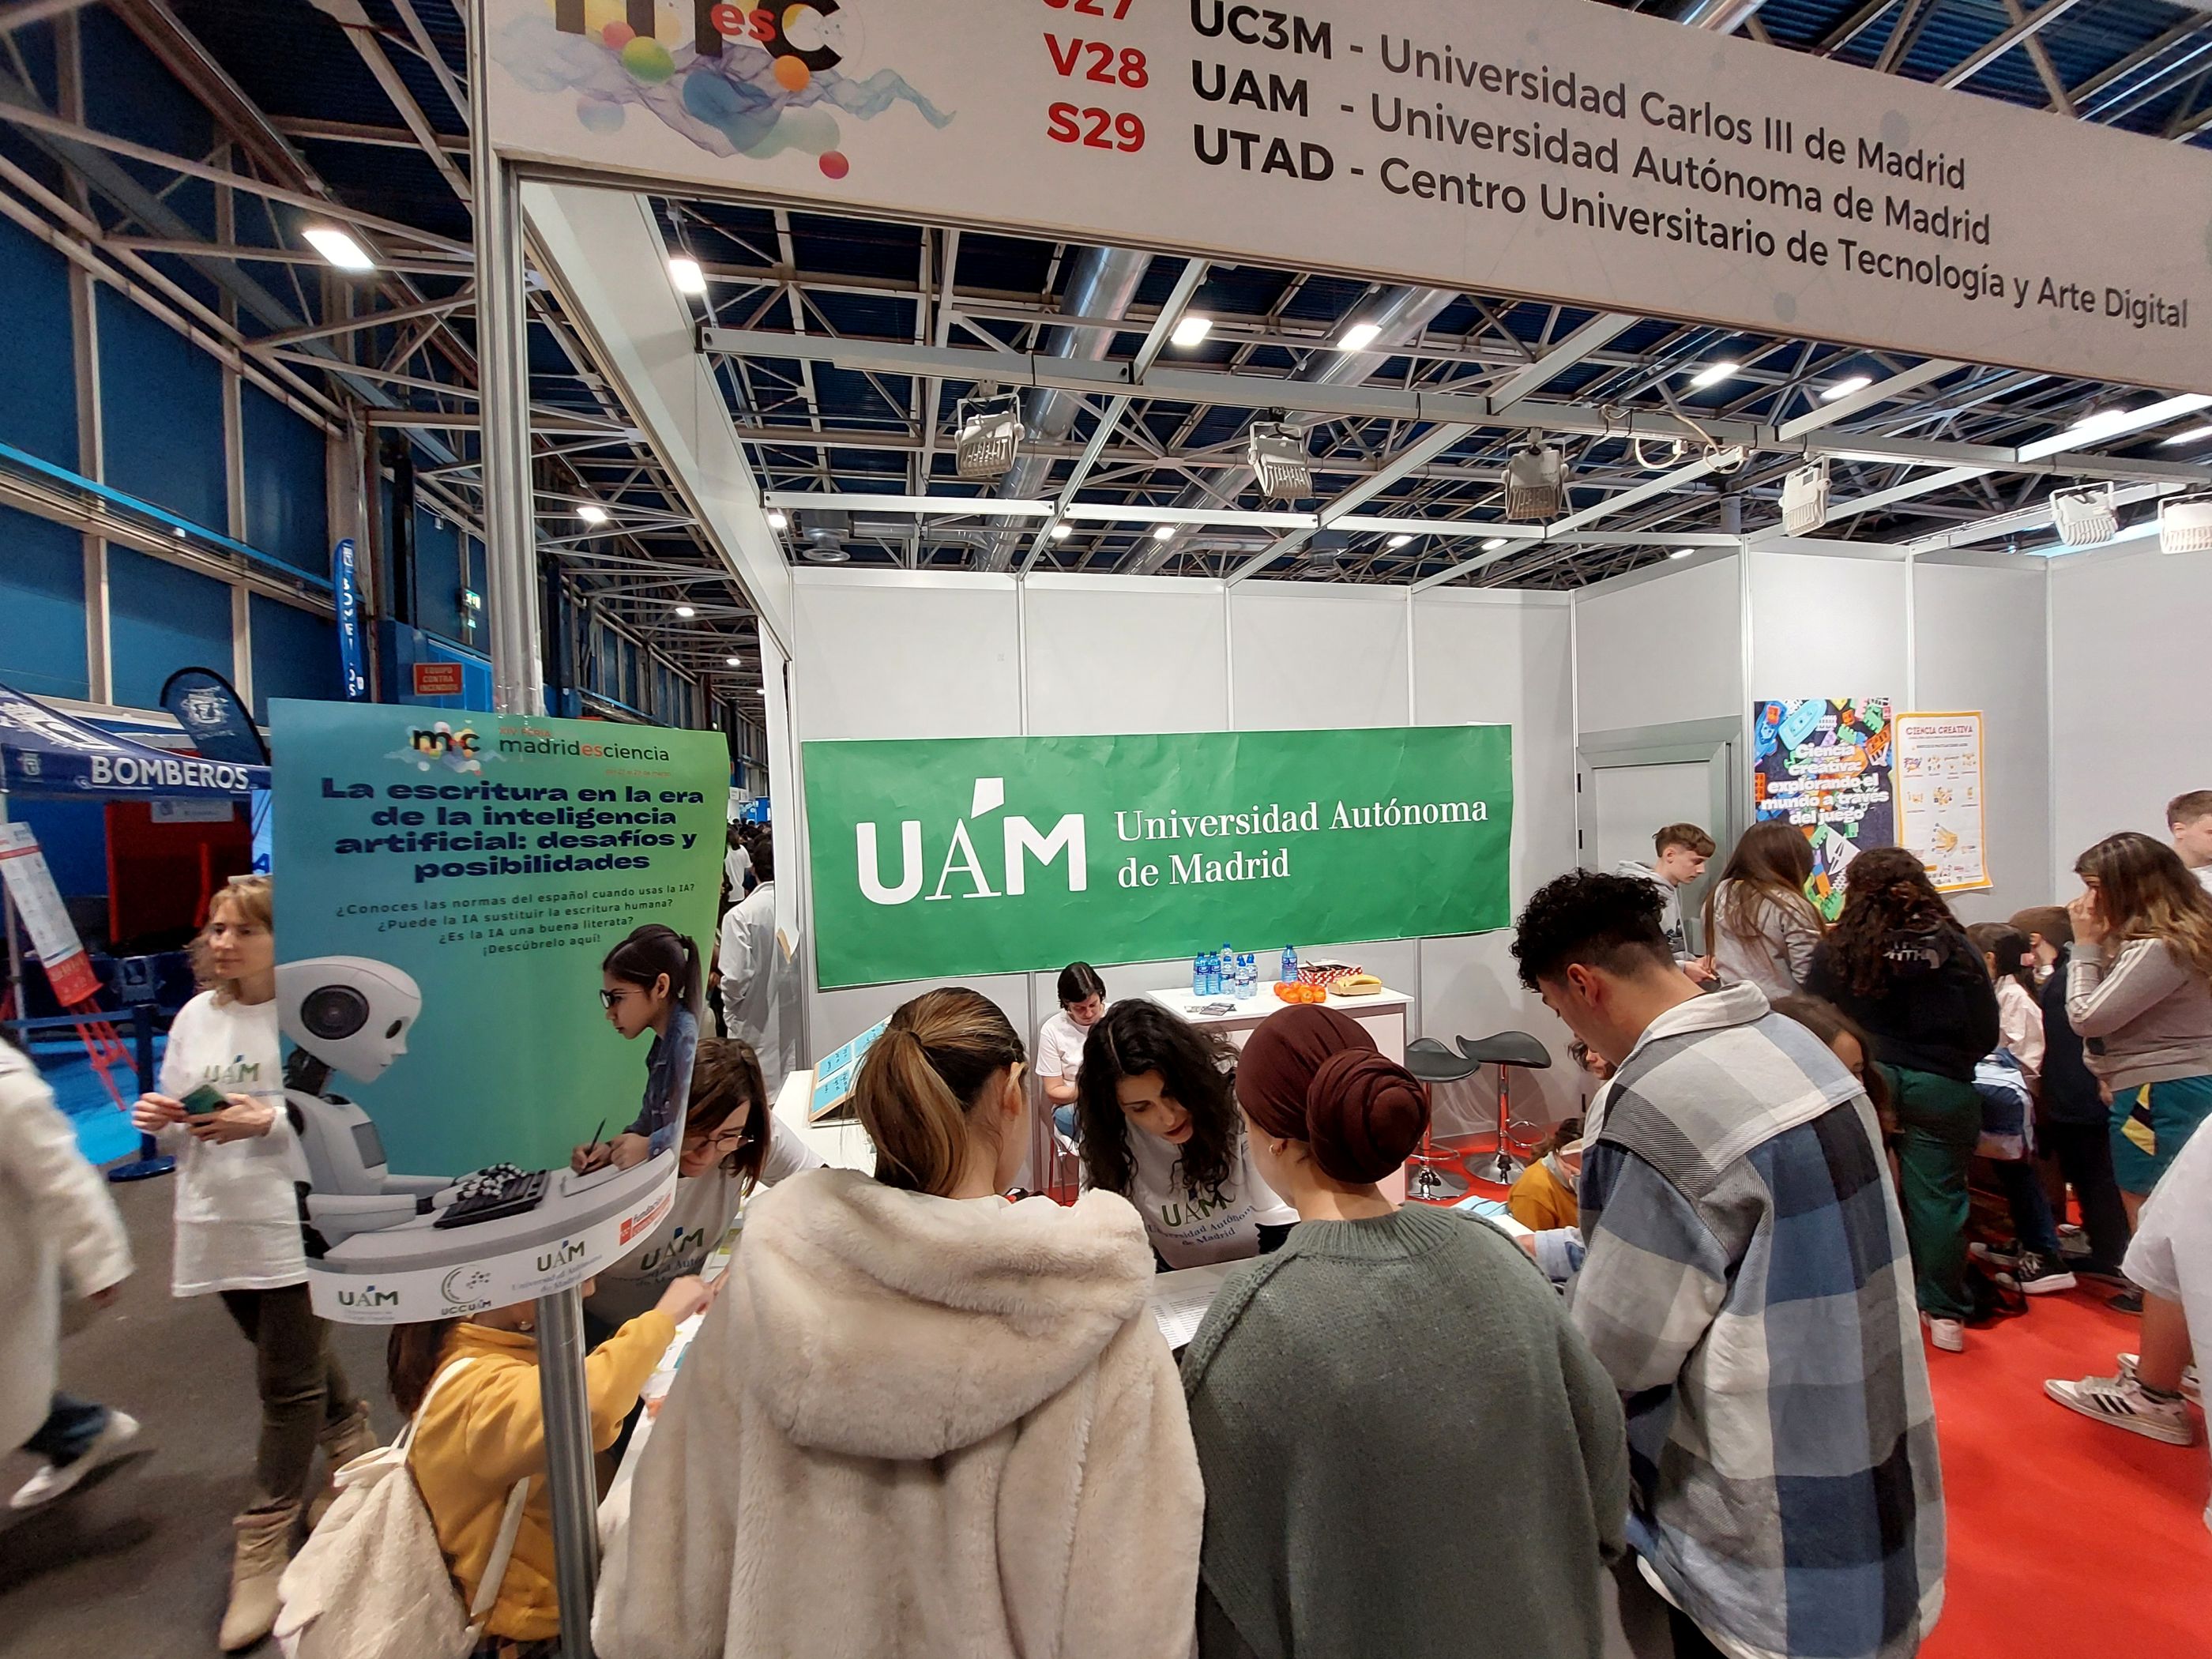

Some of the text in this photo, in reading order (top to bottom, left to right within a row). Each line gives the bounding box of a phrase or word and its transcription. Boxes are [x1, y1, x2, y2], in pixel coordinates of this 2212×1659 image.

[1191, 0, 1331, 59] UC3M
[1382, 35, 1625, 118] Universidad
[1641, 92, 1751, 145] Carlos
[1766, 118, 1791, 153] III
[1805, 127, 1845, 164] de
[1859, 138, 1964, 190] Madrid
[1044, 33, 1149, 88] V28
[1192, 60, 1307, 117] UAM
[1372, 93, 1618, 174] Universidad
[1632, 147, 1821, 214] Autónoma
[1834, 186, 1873, 222] de
[1886, 196, 1989, 245] Madrid
[1048, 102, 1145, 152] S29
[1194, 124, 1334, 181] UTAD
[1381, 158, 1525, 213] Centro
[1541, 184, 1775, 256] Universitario
[1787, 230, 1828, 265] de
[1838, 239, 2003, 300] Tecnología
[2014, 277, 2029, 308] y
[2037, 276, 2095, 312] Arte
[2105, 288, 2187, 329] Digital
[1905, 725, 1973, 735] CIENCIA CREATIVA
[500, 738, 670, 762] madridesciencia
[1795, 743, 1856, 759] Ciencia
[90, 754, 249, 789] BOMBEROS
[1767, 772, 1879, 794] explorando el
[322, 777, 704, 805] La escritura en la era
[1761, 795, 1820, 810] mundo
[1823, 795, 1834, 805] a
[371, 806, 675, 829] de la inteligencia
[1115, 802, 1319, 841] Universidad
[1329, 799, 1488, 829] Autónoma
[1789, 807, 1865, 826] del juego
[335, 830, 698, 854] artificial: desafíos y
[415, 853, 649, 883] posibilidades
[1119, 848, 1290, 887] de Madrid
[336, 882, 695, 917] ¿Conoces las normas del español cuando usas la IA?
[378, 898, 673, 932] ¿Puede la IA sustituir la escritura humana?
[438, 916, 634, 944] ¿Es la IA una buena literata?
[483, 933, 601, 956] ¡Descúbrelo aquí!
